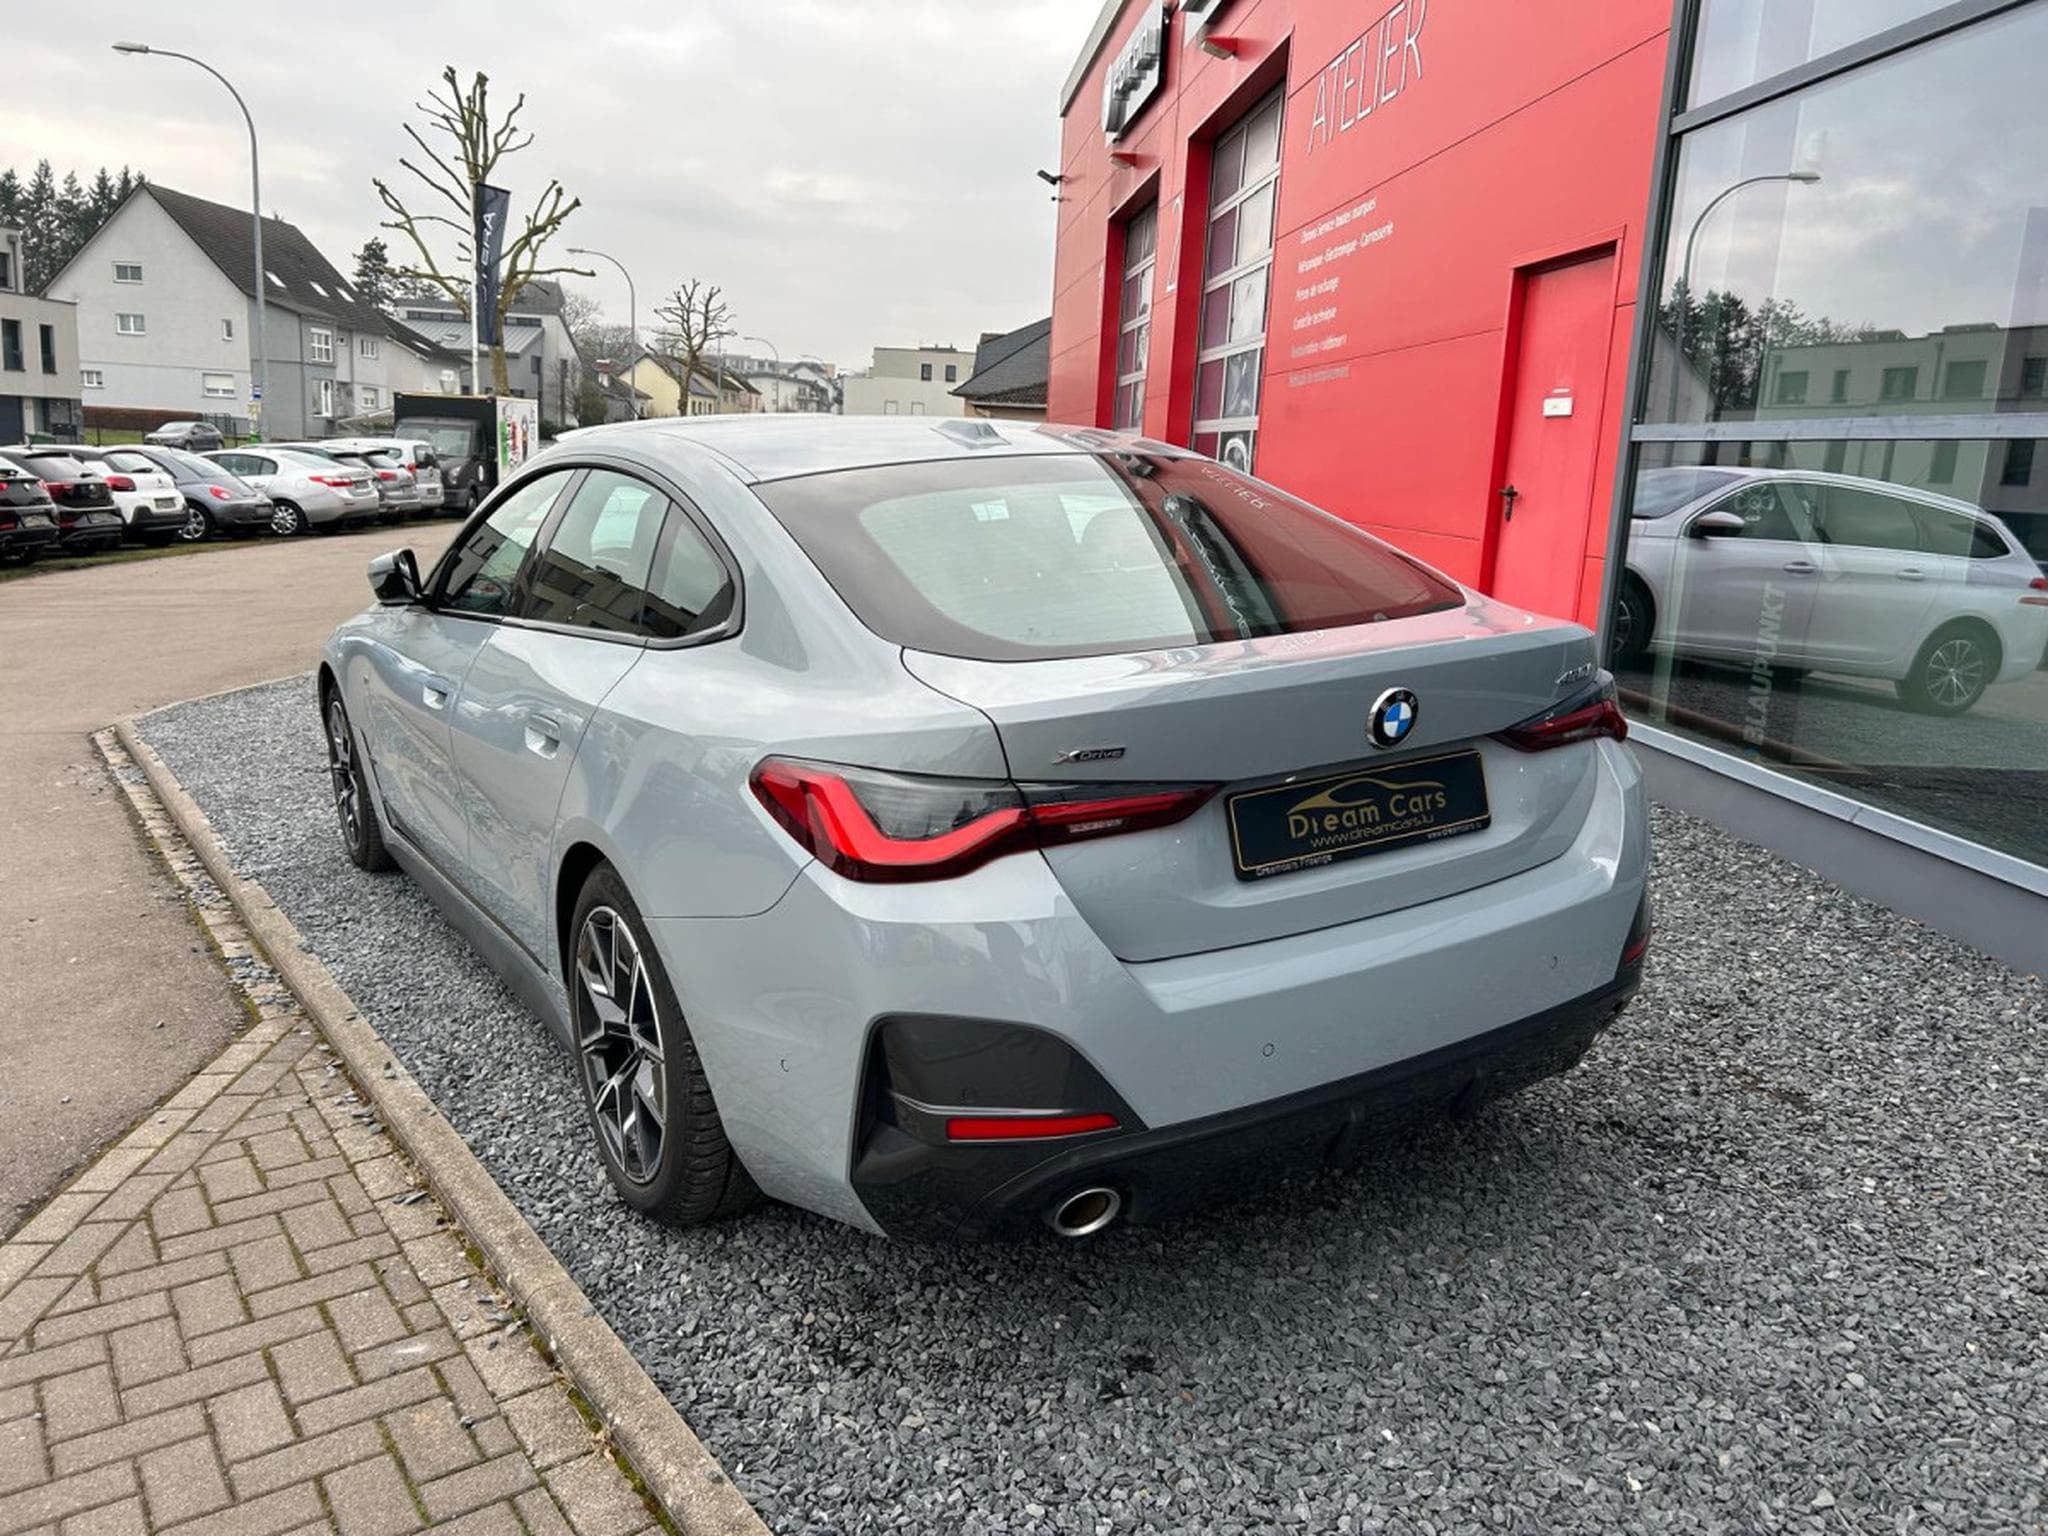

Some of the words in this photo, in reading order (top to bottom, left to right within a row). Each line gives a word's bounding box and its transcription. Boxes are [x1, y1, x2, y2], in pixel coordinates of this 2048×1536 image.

[1307, 0, 1427, 155] ATELIER
[1742, 582, 1787, 743] BLAUPUNKT
[1288, 804, 1381, 839] Dream
[1389, 790, 1447, 818] Cars
